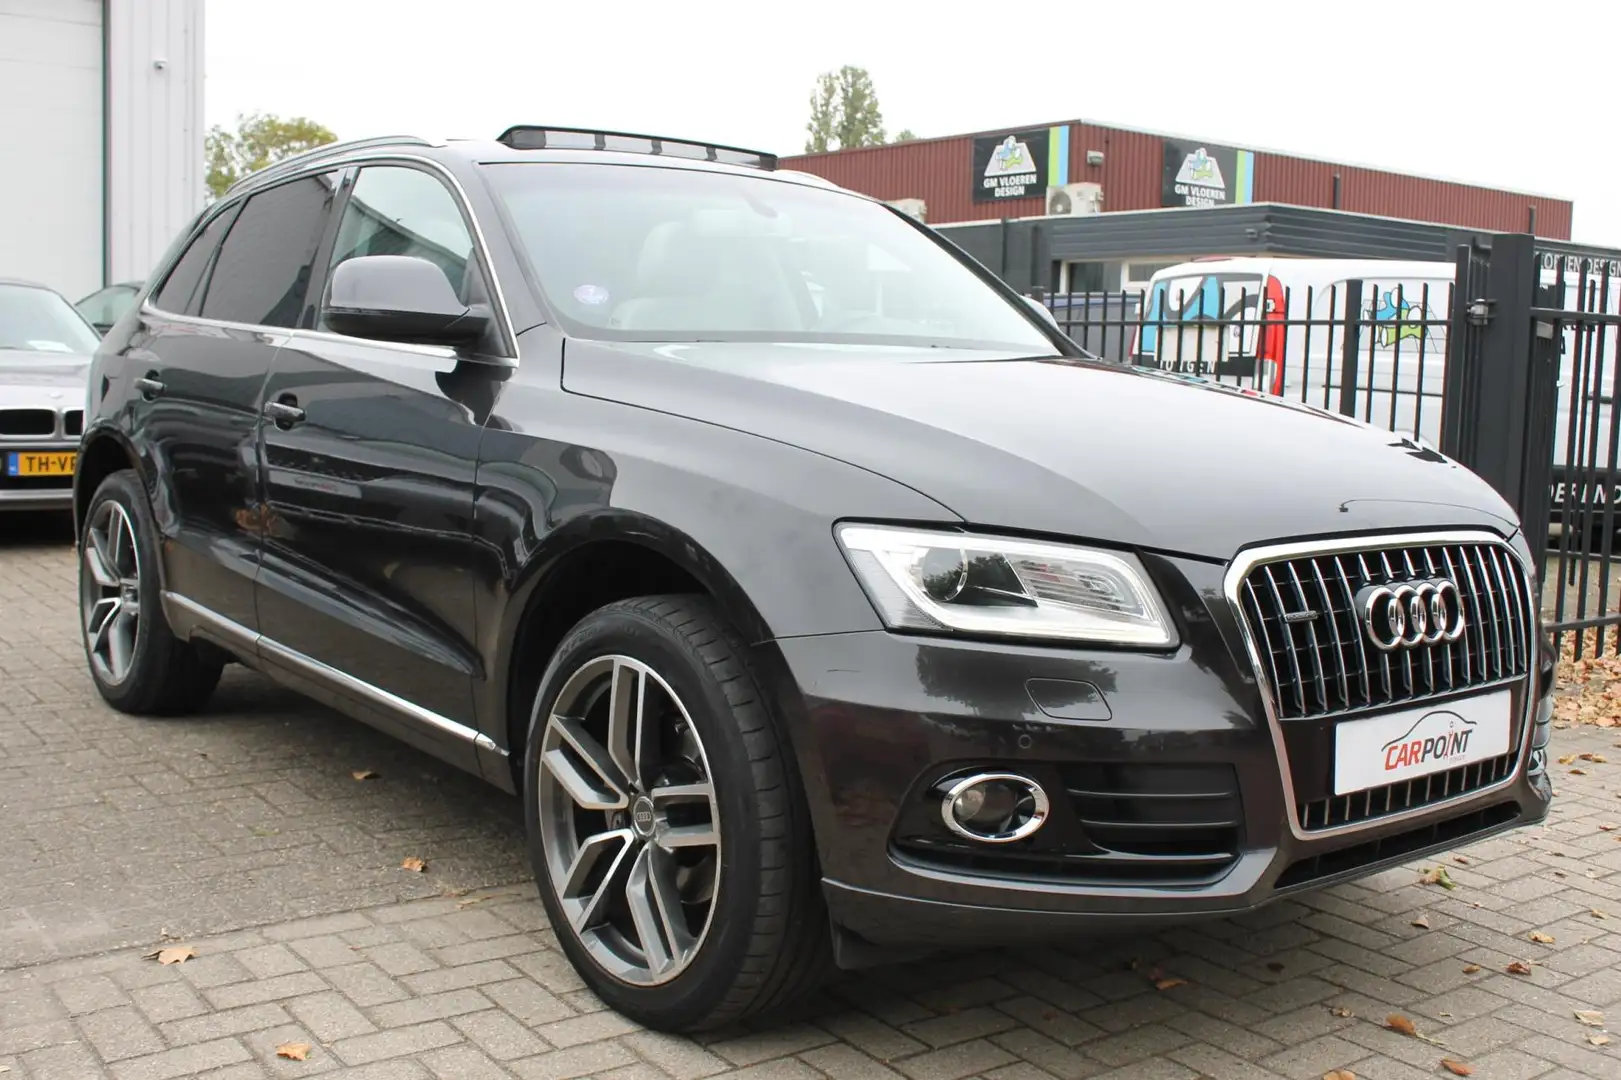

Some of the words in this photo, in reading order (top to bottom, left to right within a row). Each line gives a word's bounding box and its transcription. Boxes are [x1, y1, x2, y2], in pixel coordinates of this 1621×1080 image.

[983, 177, 998, 188] GM
[999, 173, 1037, 186] VLOEREN
[994, 185, 1025, 197] DESIGN
[1174, 183, 1189, 195] GM
[1190, 185, 1226, 200] VLOEREN
[1385, 726, 1473, 771] CARPOINT
